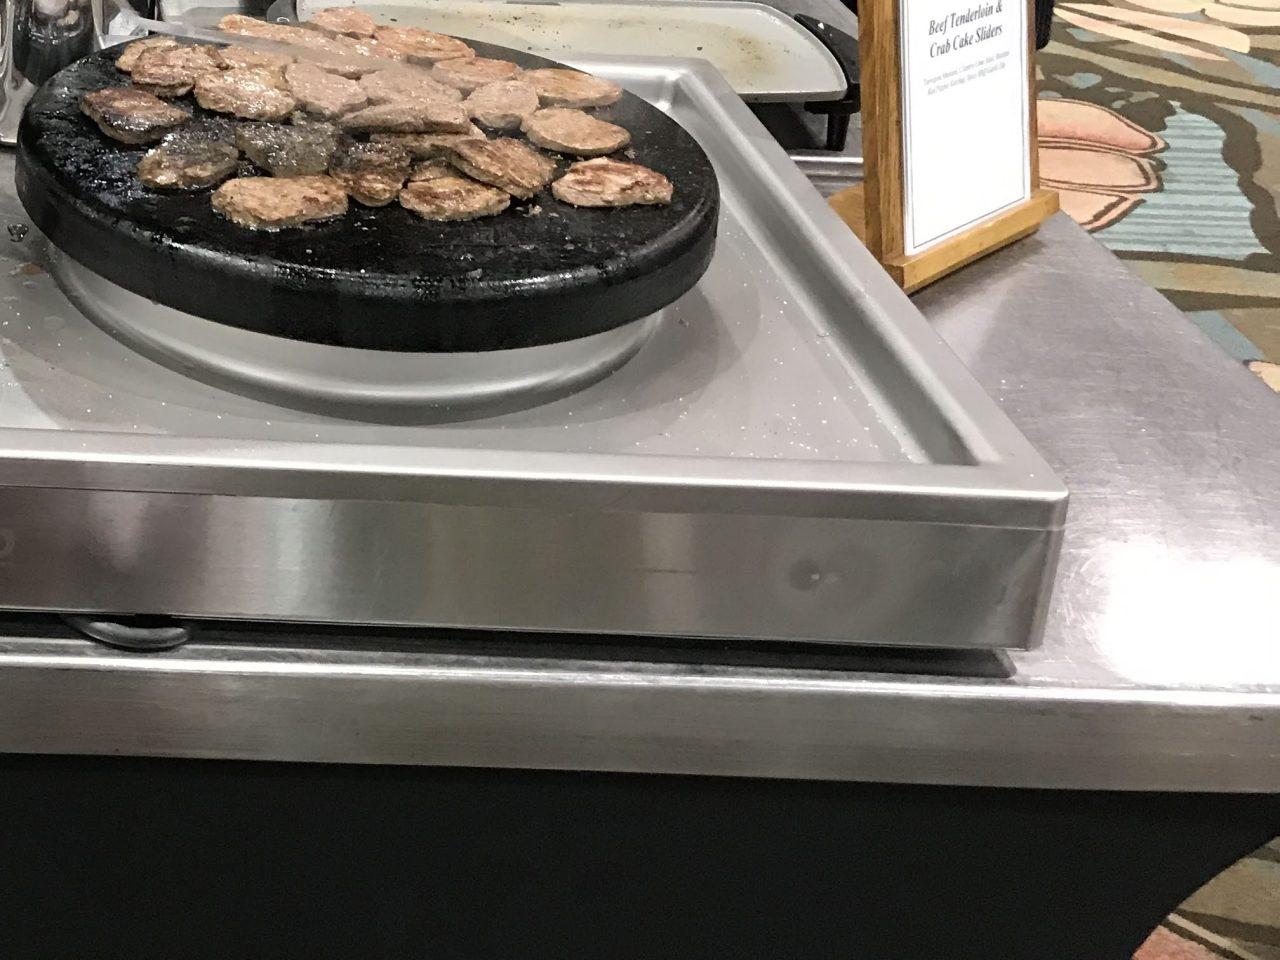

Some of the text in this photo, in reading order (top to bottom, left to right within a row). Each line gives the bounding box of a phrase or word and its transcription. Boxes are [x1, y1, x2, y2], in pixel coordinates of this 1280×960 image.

[928, 15, 949, 36] Beef
[950, 2, 994, 28] Tenderloin
[929, 24, 1003, 58] Crab Cake Sliders
